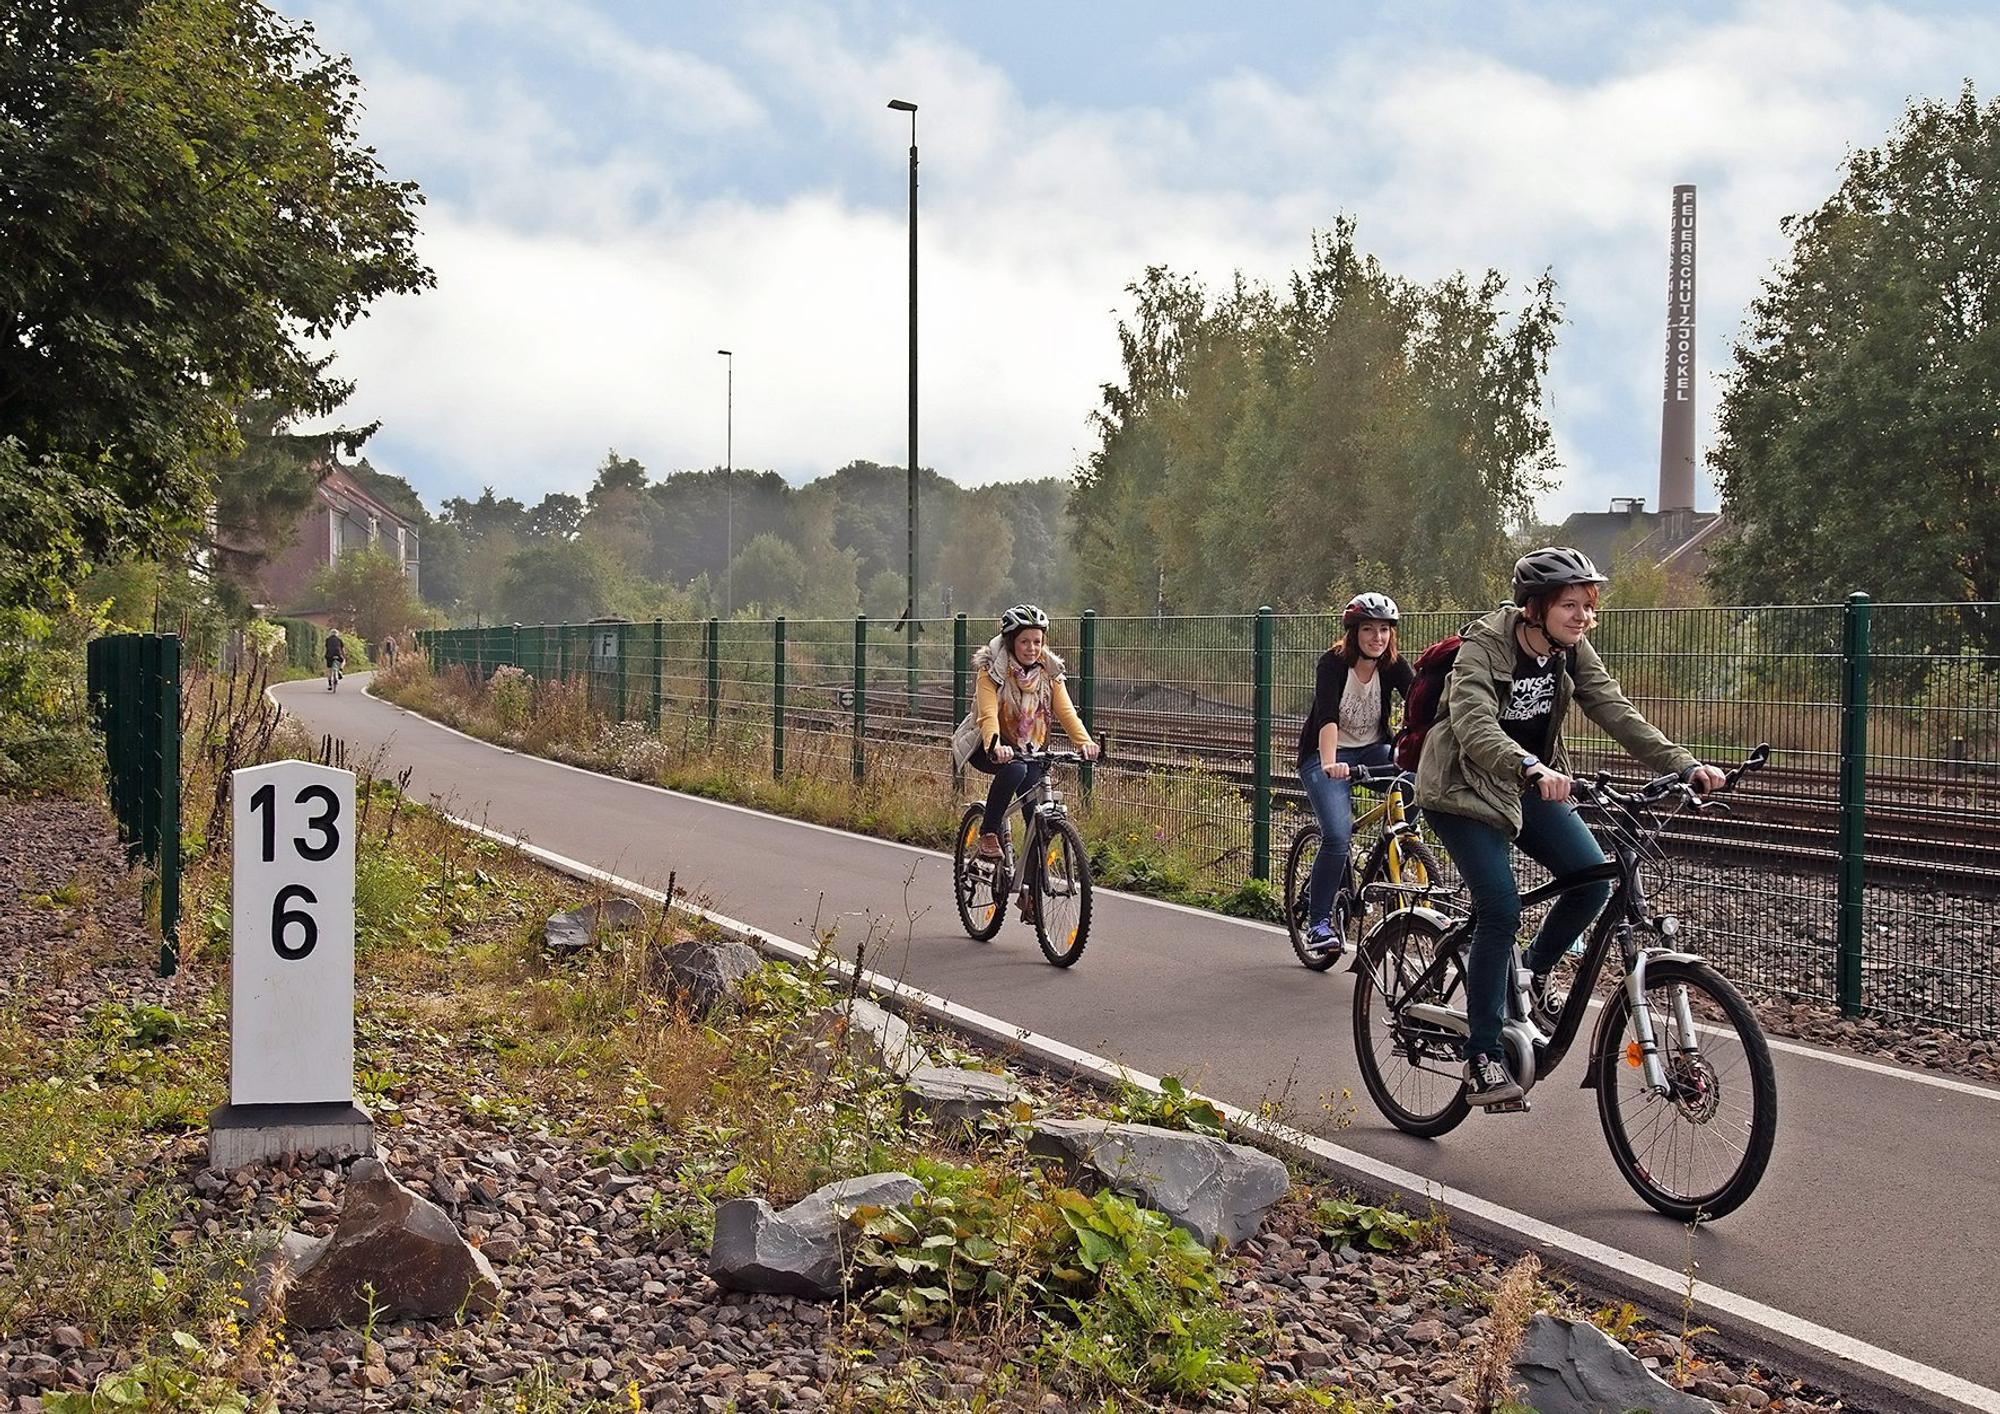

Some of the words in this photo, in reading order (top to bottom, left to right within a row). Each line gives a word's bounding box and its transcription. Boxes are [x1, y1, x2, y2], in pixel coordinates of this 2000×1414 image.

[1679, 192, 1694, 327] FEUERSCHUTZ
[1676, 328, 1690, 401] JOCKEL
[249, 783, 341, 863] 13
[269, 883, 319, 961] 6
